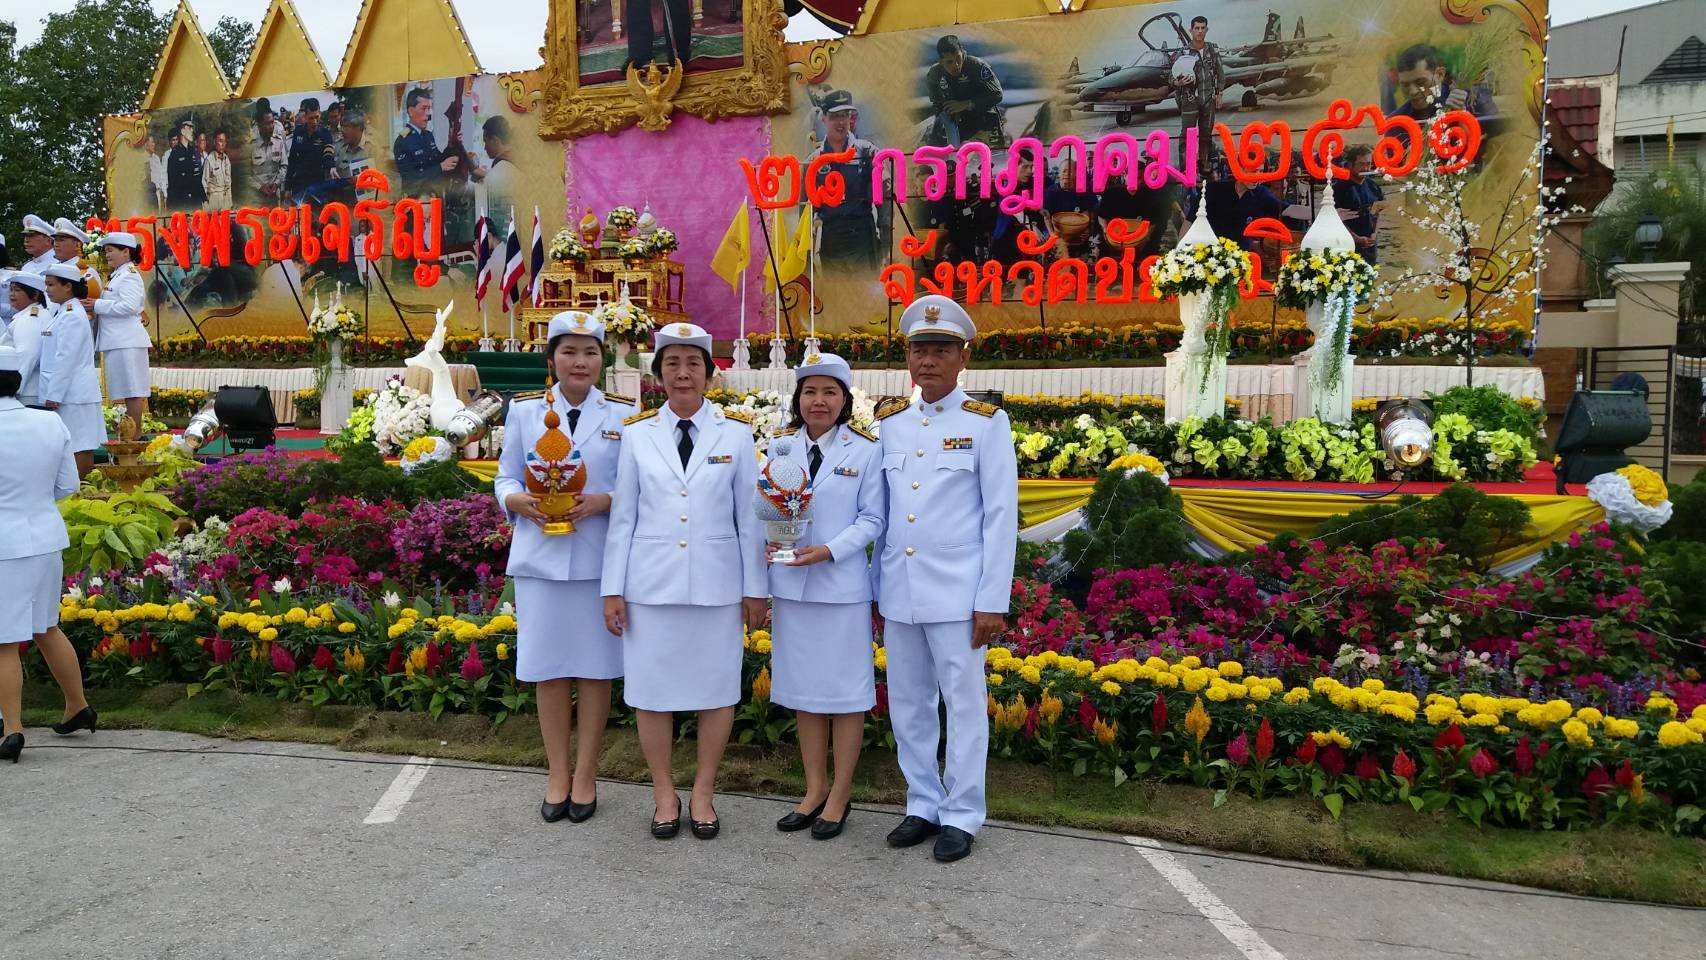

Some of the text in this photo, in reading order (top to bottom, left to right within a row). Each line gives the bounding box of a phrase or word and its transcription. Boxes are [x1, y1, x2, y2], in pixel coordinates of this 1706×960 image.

[739, 98, 1483, 215] ๒๘ กรกฎาคม ๒๕๖๑
